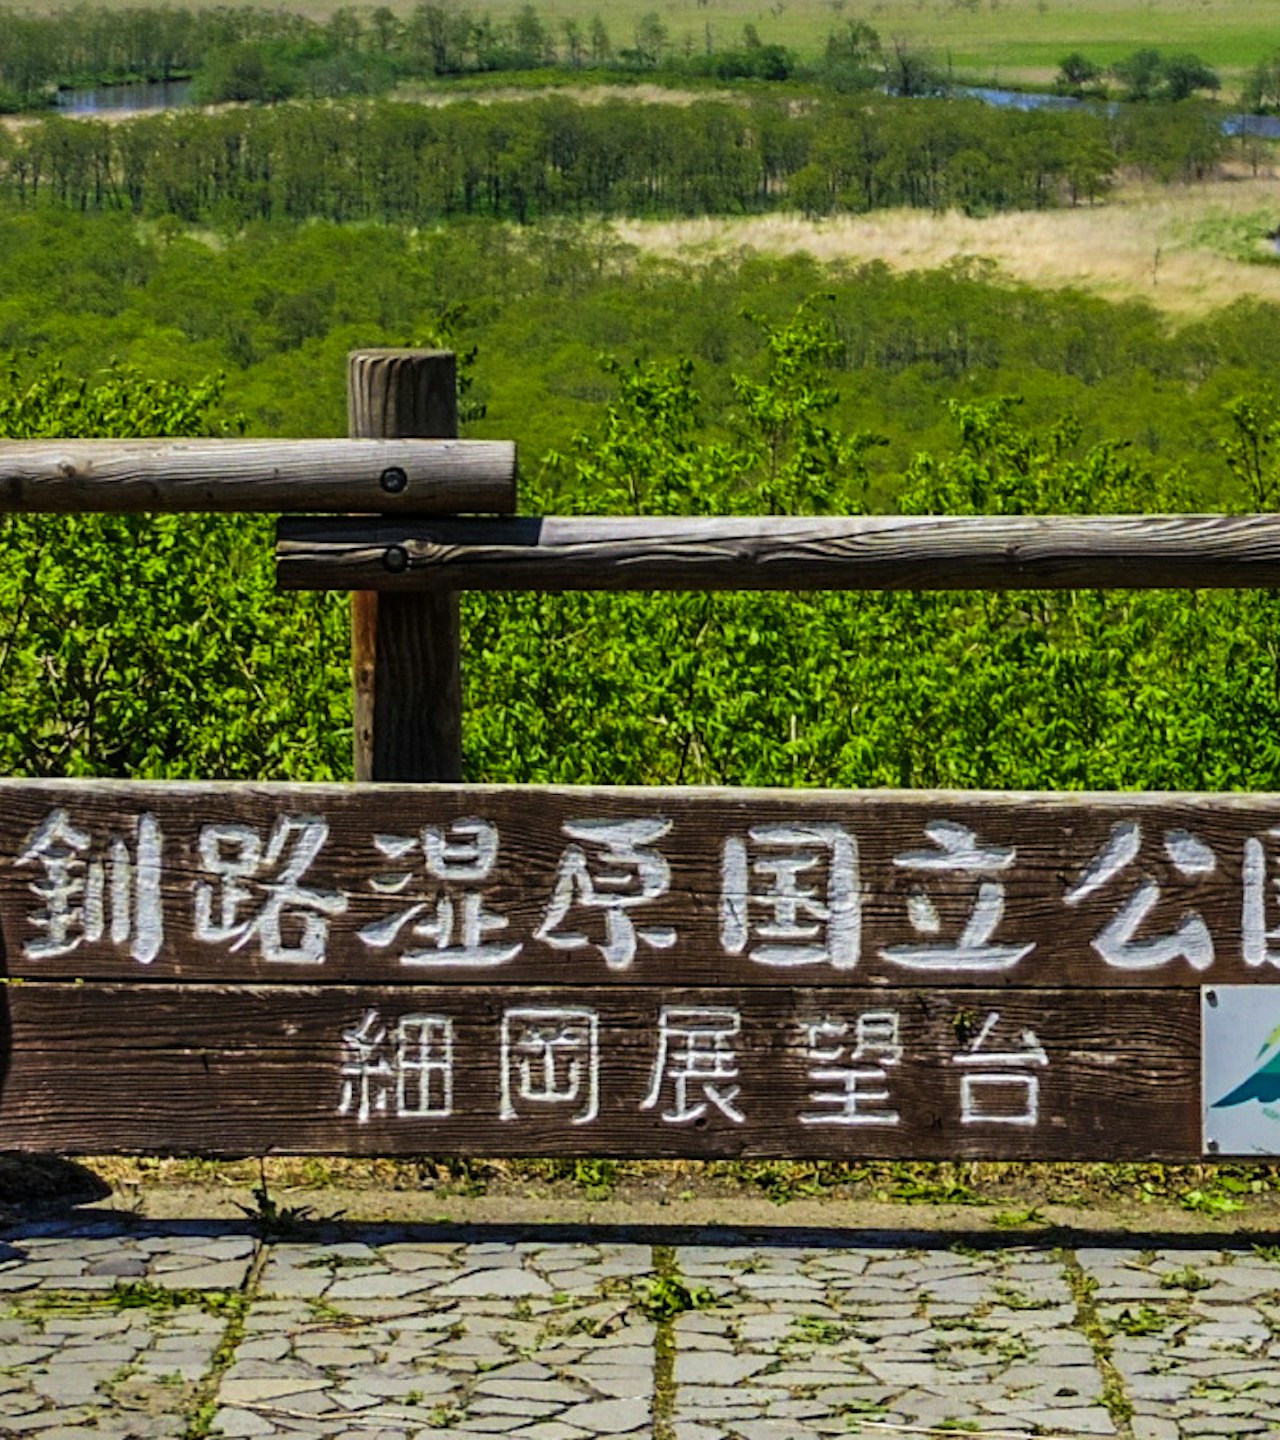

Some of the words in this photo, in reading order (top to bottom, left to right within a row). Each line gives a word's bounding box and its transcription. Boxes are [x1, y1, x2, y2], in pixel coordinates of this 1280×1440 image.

[336, 1005, 1049, 1127] 細岡展望台
